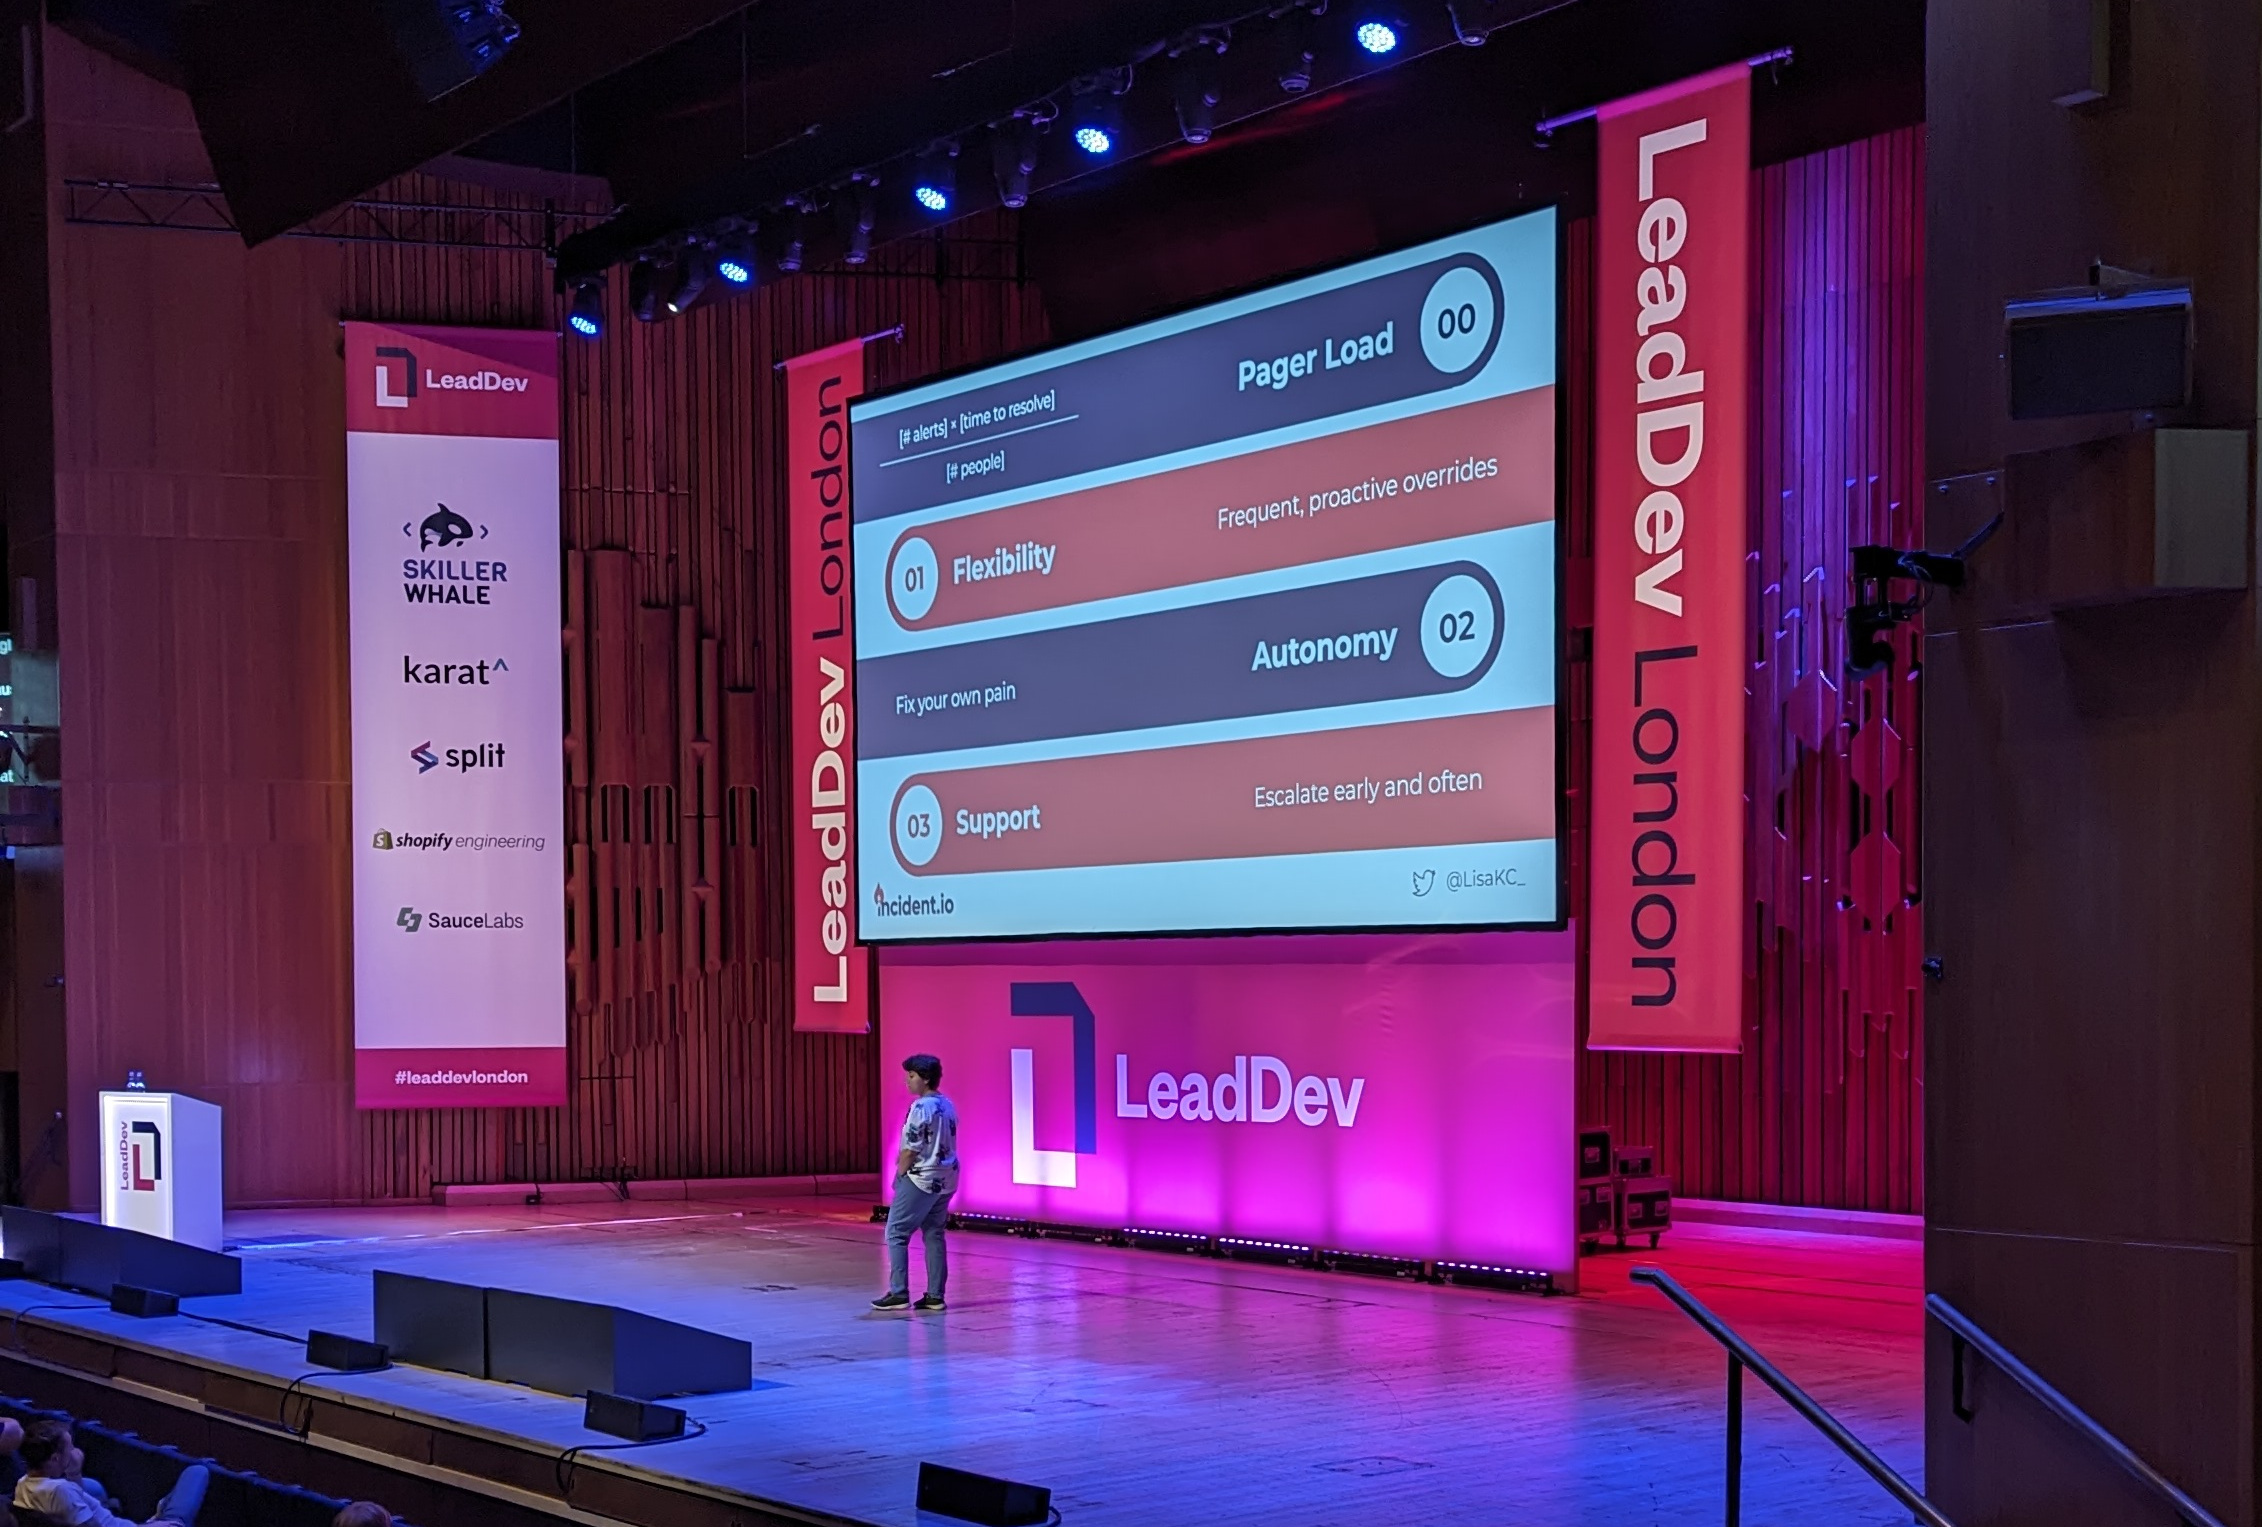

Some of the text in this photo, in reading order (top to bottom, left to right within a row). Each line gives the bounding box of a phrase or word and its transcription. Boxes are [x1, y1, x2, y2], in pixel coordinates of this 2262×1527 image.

[1437, 303, 1476, 340] 00
[1238, 321, 1394, 391] Pager Load
[426, 369, 529, 392] LeadDev
[899, 428, 911, 450] [#
[913, 418, 948, 442] alerts]
[959, 409, 991, 434] [time
[993, 406, 1006, 420] to
[1008, 389, 1055, 417] resolve]
[946, 450, 1005, 484] [# people]
[1217, 456, 1498, 530] Frequent, proactive overrides
[403, 559, 508, 582] SKILLER
[905, 566, 924, 592] 01
[953, 541, 1056, 585] Flexibility
[1631, 118, 1707, 1007] LeadDev London
[403, 583, 491, 605] WHALE
[1439, 610, 1476, 643] 02
[1251, 627, 1398, 671] Autonomy
[811, 376, 847, 1003] LeadDev London
[896, 681, 1016, 717] Fix your own pain
[445, 743, 506, 774] split
[1255, 769, 1483, 807] Escalate early and often
[907, 813, 930, 838] 03
[956, 805, 1041, 839] Support
[395, 833, 545, 851] shopify engineering
[1446, 868, 1526, 892] @LisaKC_
[428, 912, 524, 929] SauceLabs
[877, 893, 955, 917] incident.io
[394, 1069, 529, 1087] #leaddevlondon
[1116, 1054, 1364, 1127] LeadDev
[120, 1121, 129, 1190] LeadDev
